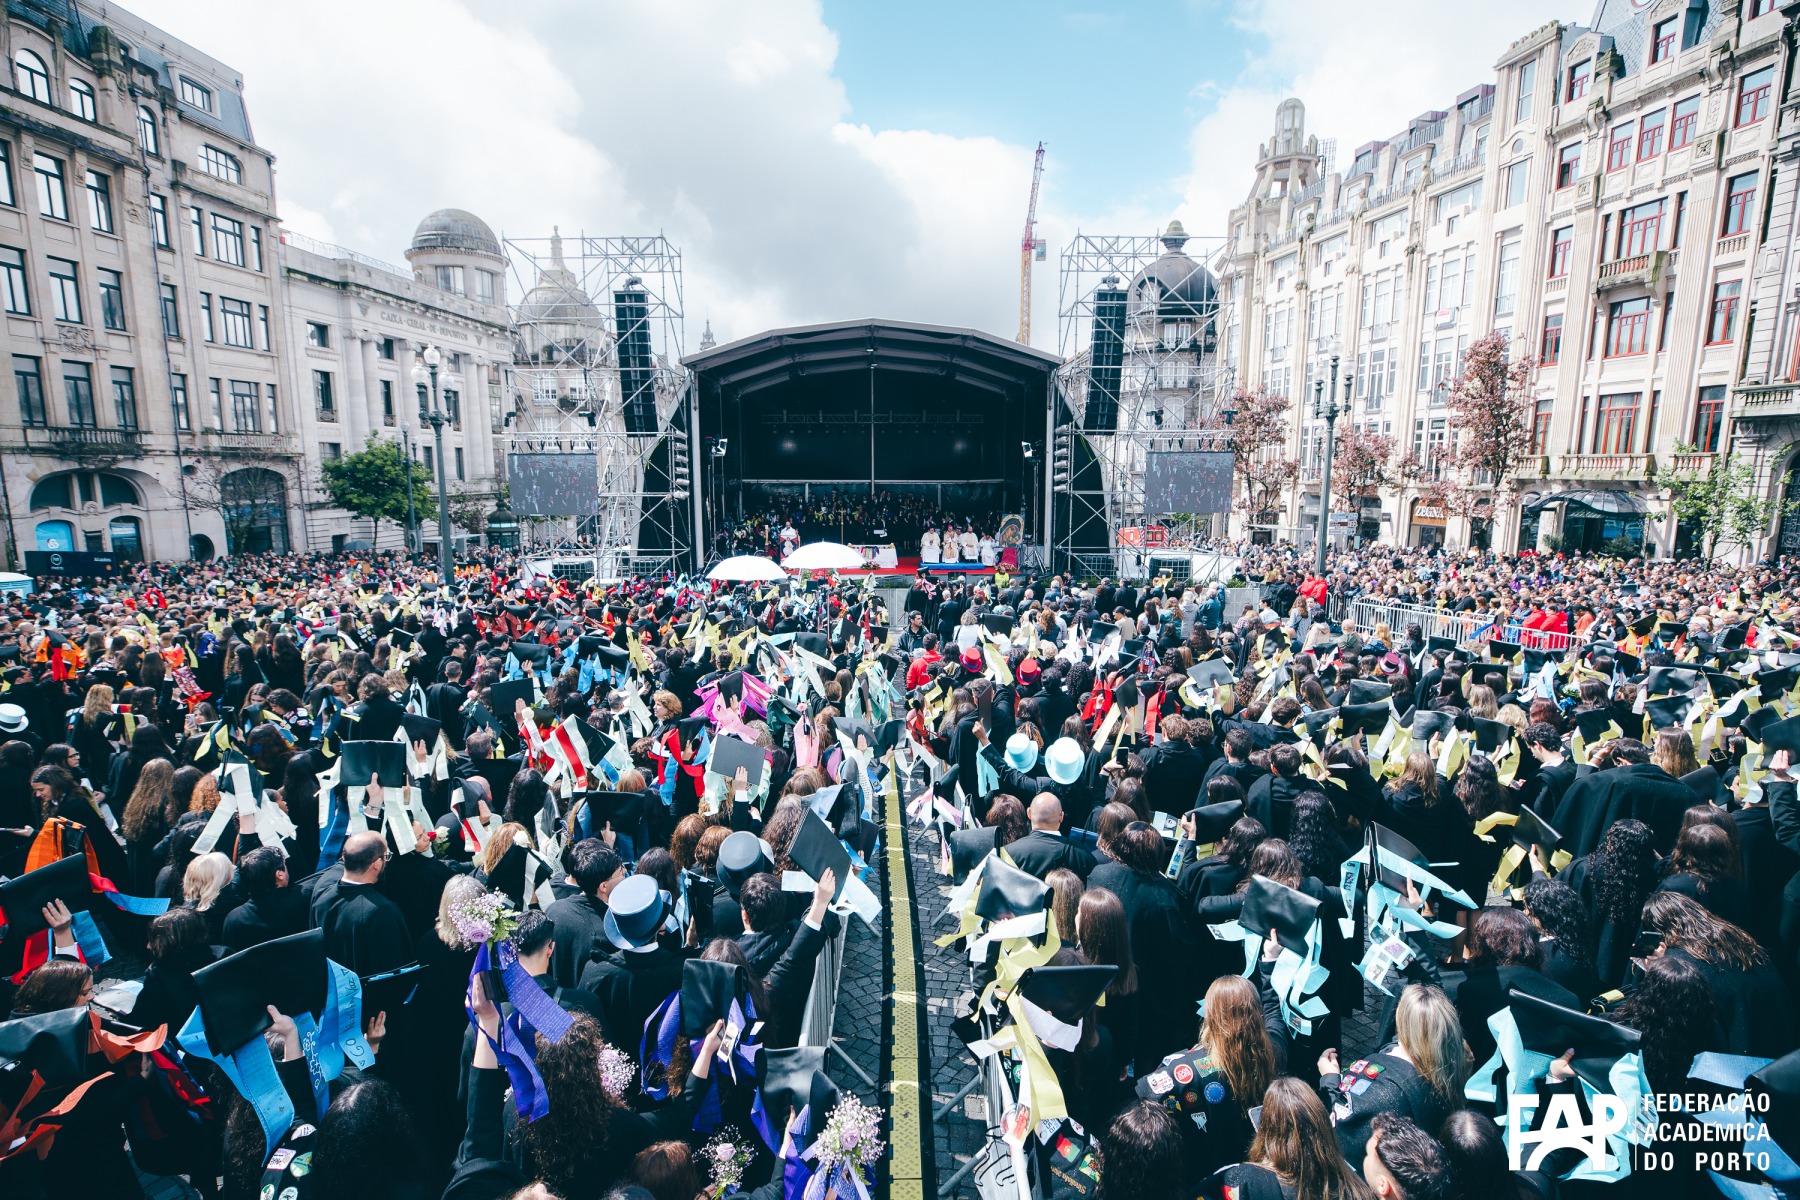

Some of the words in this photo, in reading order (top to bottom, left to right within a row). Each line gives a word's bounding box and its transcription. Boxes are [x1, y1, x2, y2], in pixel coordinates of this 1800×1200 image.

[380, 310, 404, 325] CAIXA
[406, 317, 426, 331] GERAL
[429, 323, 438, 333] DE
[1414, 505, 1444, 518] ZEGNA
